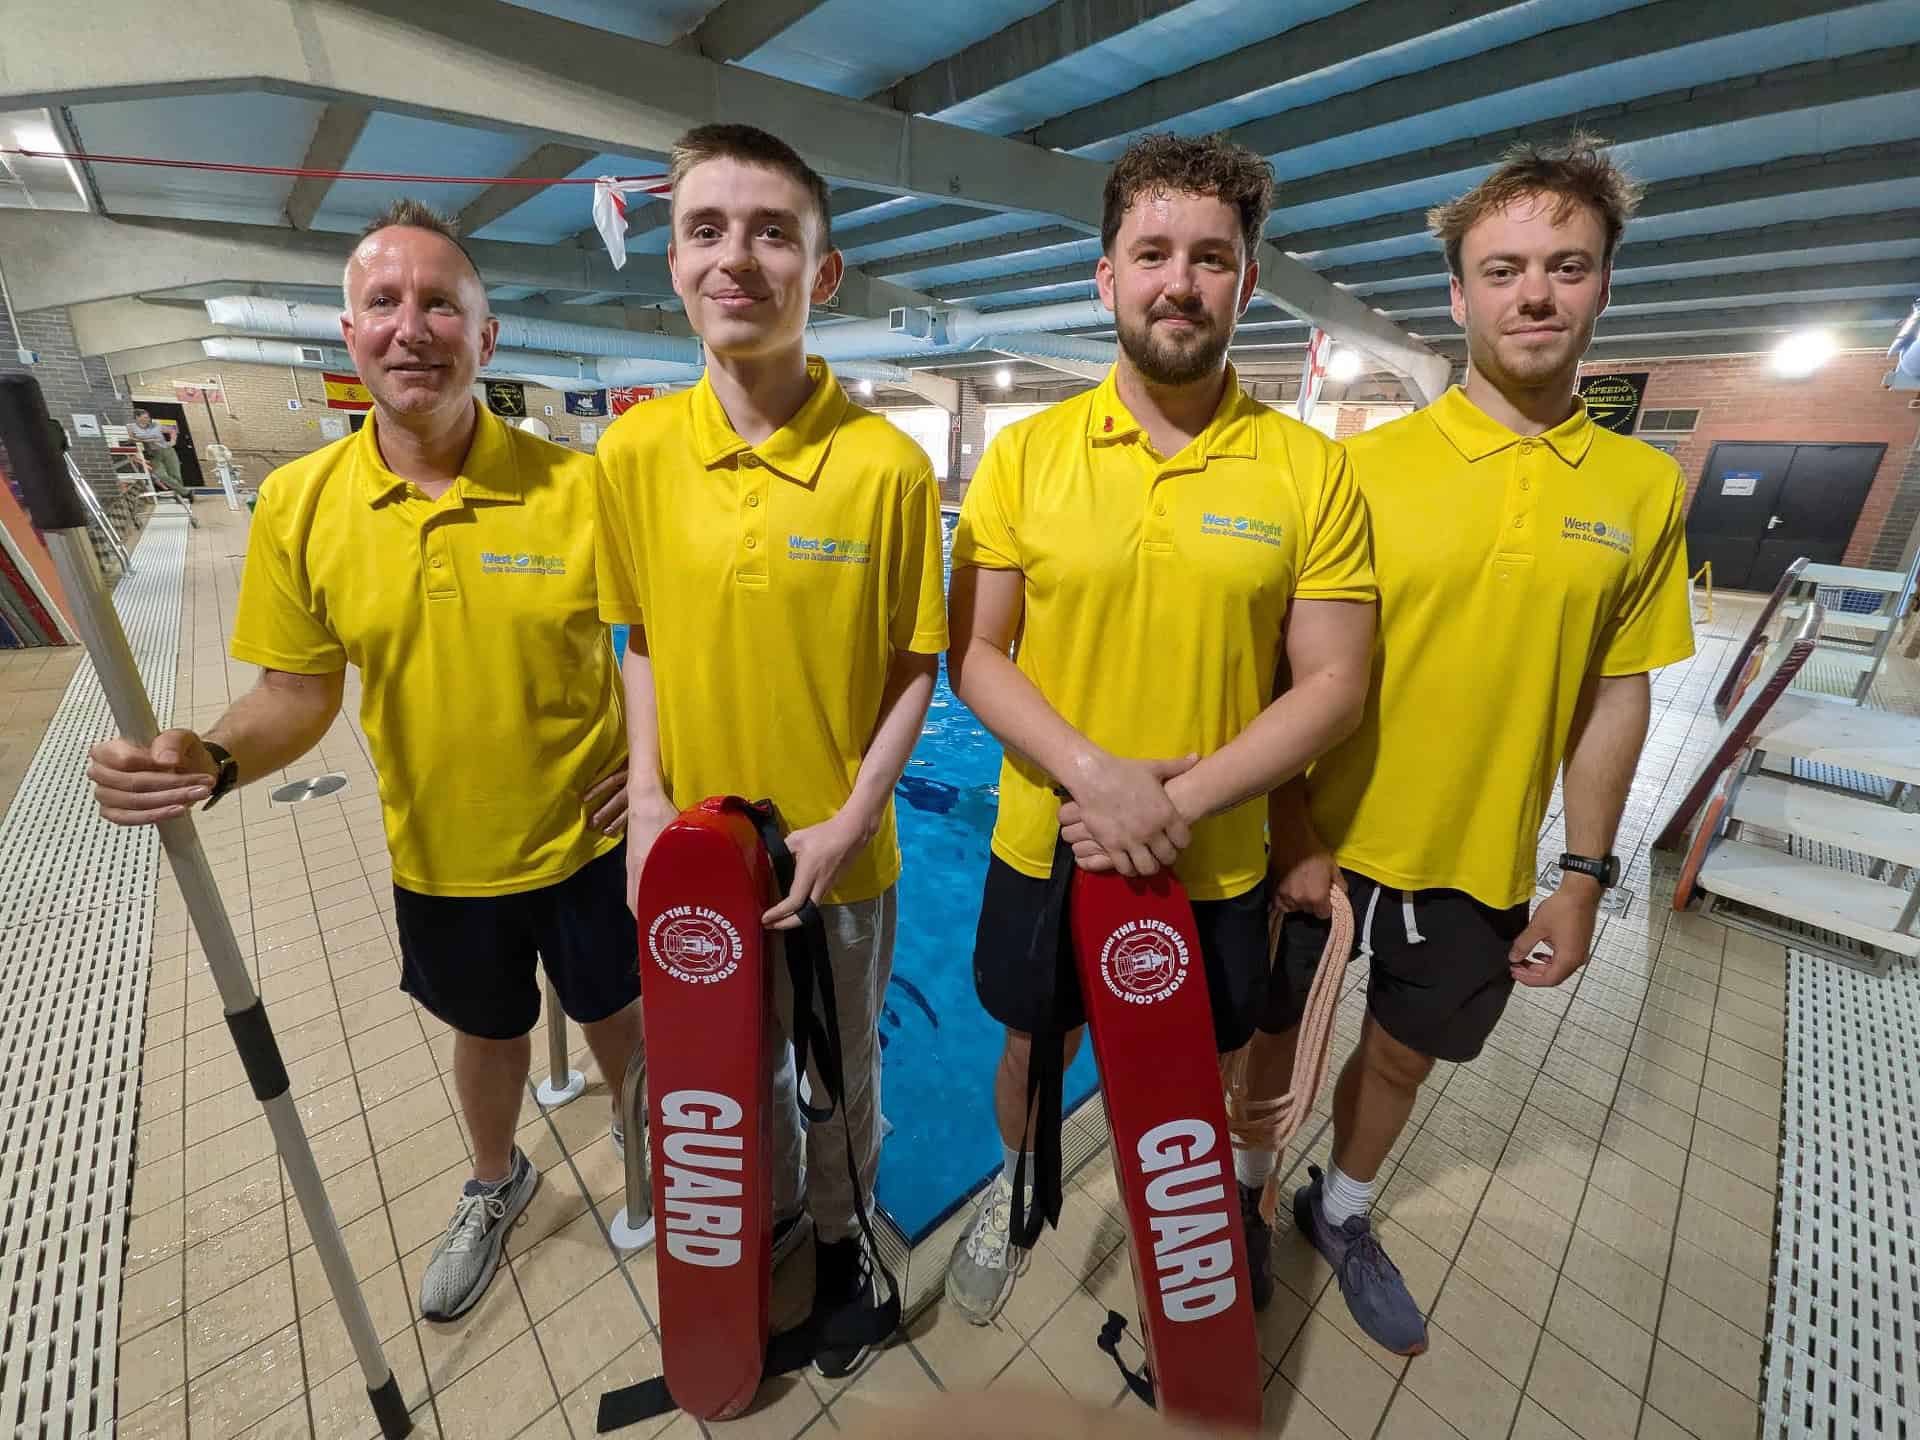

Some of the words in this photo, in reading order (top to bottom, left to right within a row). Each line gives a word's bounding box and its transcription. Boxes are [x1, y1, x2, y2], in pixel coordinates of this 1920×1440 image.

[1589, 386, 1629, 394] SPEEDO
[1203, 512, 1232, 527] West
[1249, 519, 1282, 537] Wight
[1563, 516, 1591, 531] West
[788, 535, 819, 550] West
[481, 552, 512, 564] West
[665, 905, 692, 919] THE
[695, 906, 743, 960] LIFEGUARD
[1113, 921, 1137, 940] THE
[1140, 919, 1190, 966] LIFEGUARD
[660, 1089, 743, 1269] GUARD
[1136, 1117, 1238, 1323] GUARD
